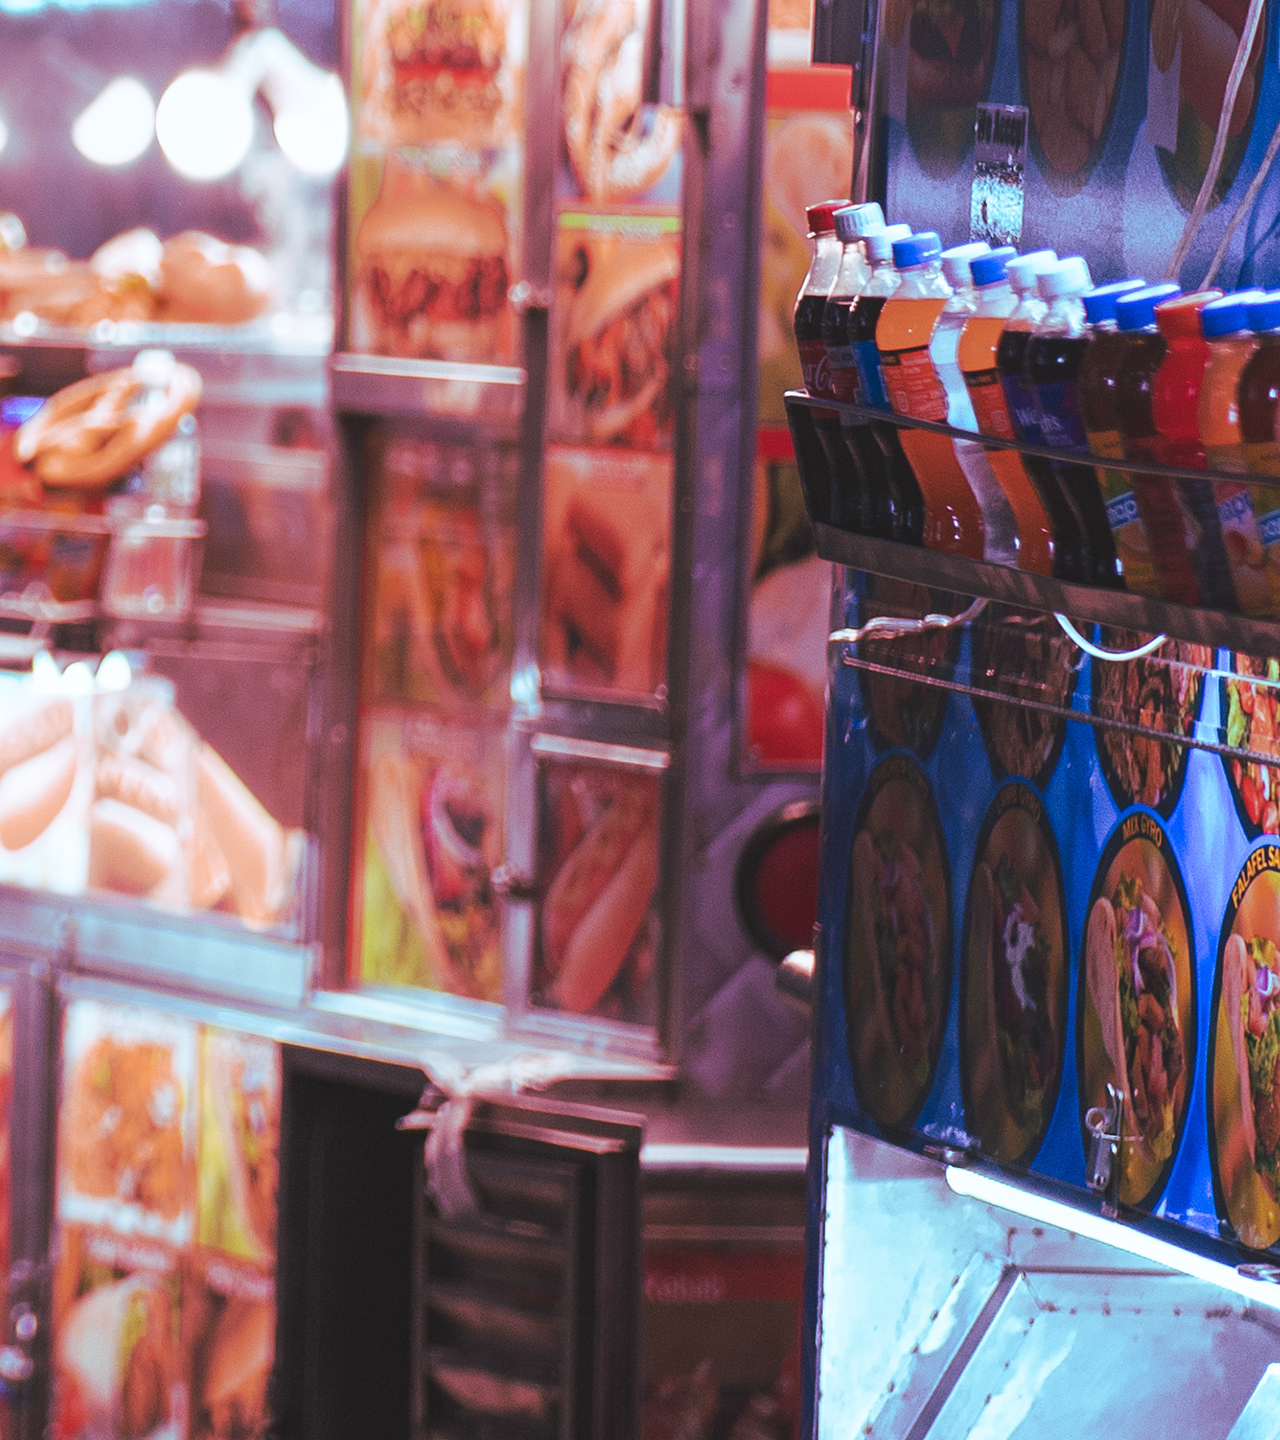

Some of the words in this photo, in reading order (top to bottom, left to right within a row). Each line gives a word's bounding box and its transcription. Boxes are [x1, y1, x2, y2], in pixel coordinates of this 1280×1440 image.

[1122, 813, 1139, 842] MIX
[1140, 813, 1162, 848] GYRO
[1231, 846, 1268, 909] FALAFEL
